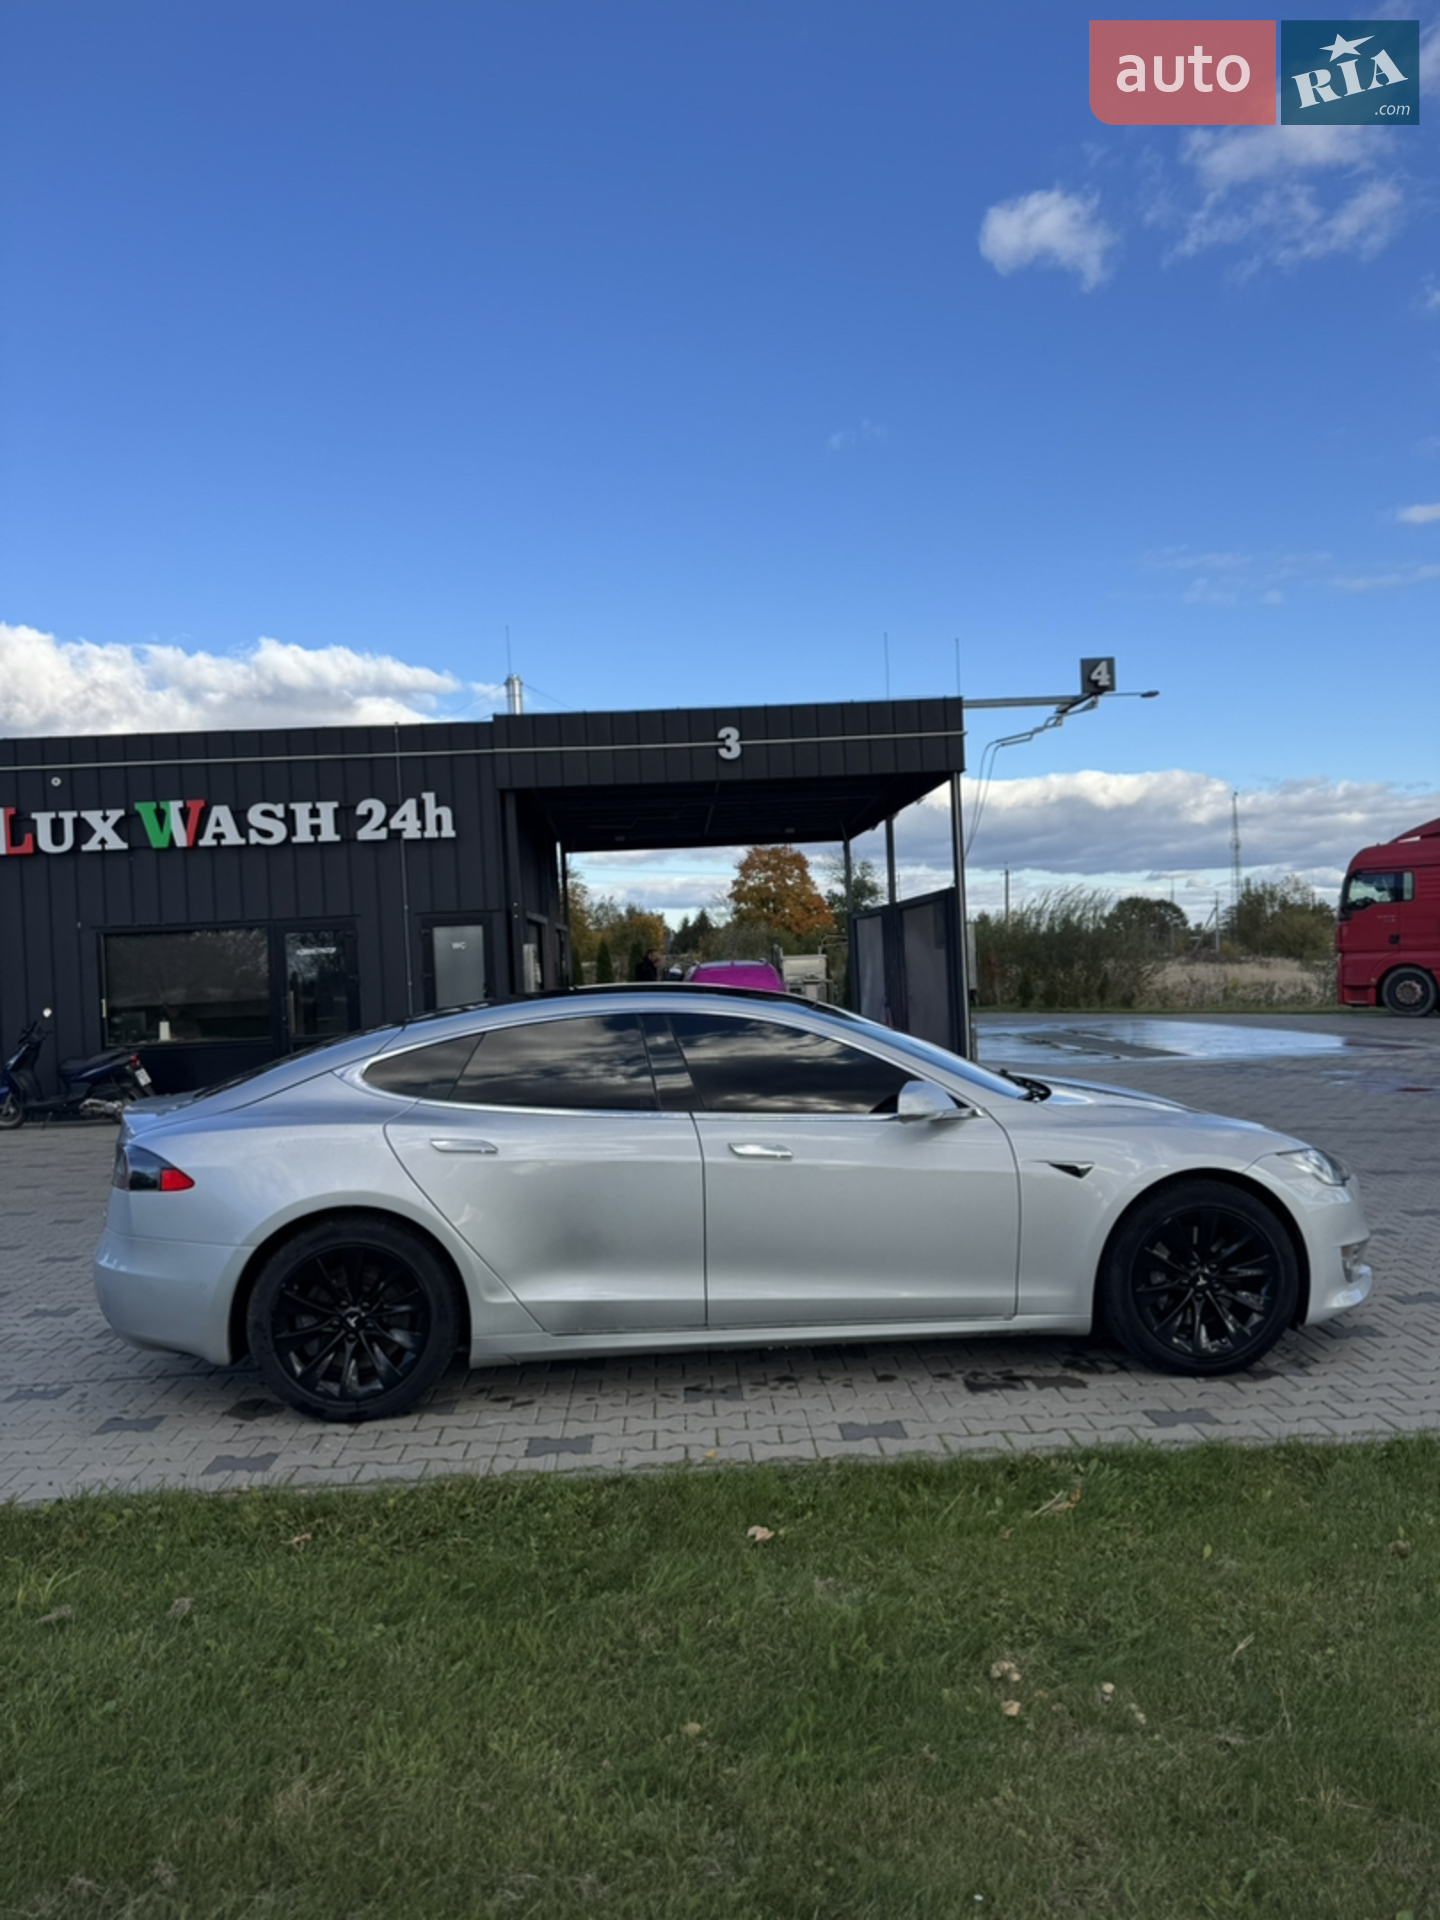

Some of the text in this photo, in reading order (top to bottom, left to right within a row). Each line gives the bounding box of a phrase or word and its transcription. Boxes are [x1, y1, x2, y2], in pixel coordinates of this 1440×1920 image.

[1090, 660, 1110, 686] 4
[717, 726, 742, 760] 3
[0, 792, 456, 856] LUX WASH 24h
